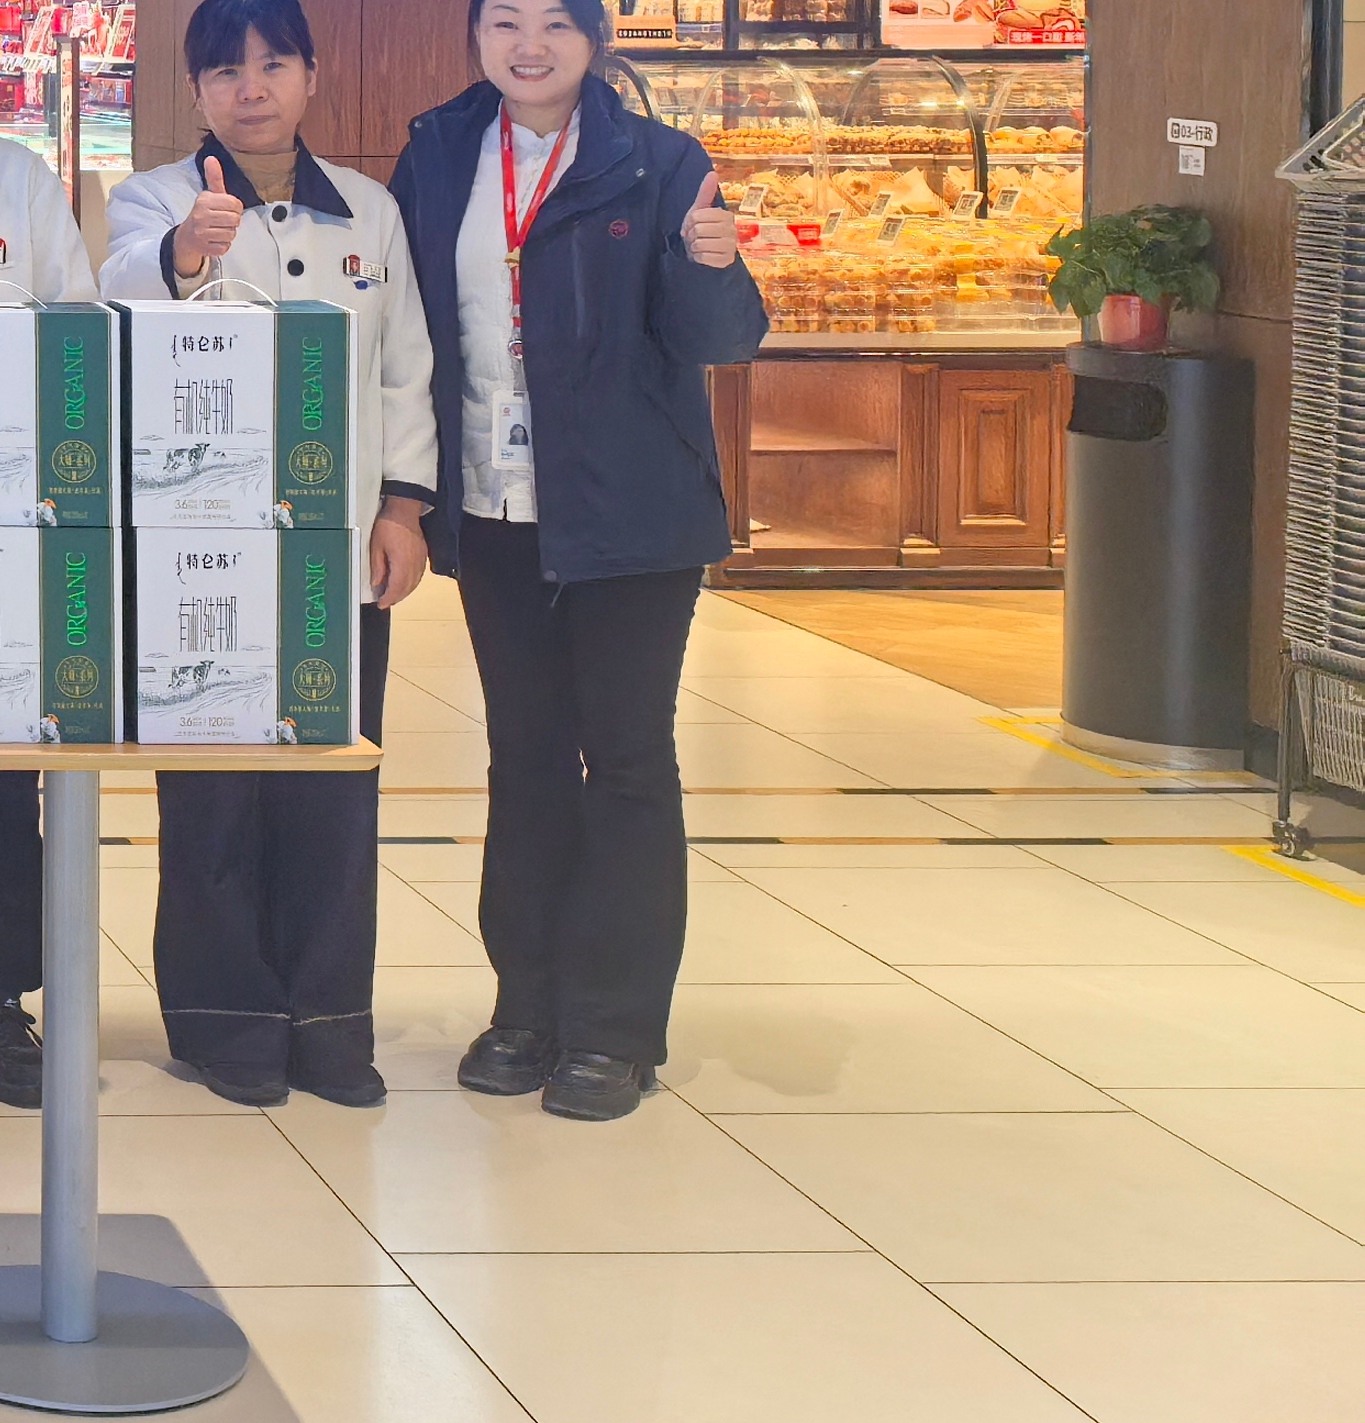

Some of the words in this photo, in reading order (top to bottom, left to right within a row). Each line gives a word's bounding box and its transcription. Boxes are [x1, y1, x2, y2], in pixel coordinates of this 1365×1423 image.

[64, 336, 85, 430] ORGANIC
[182, 336, 224, 352] 特仑苏
[302, 337, 323, 431] ORGANIC
[66, 551, 88, 646] ORGANIC
[187, 553, 229, 570] 特仑苏
[305, 553, 327, 647] ORGANIC
